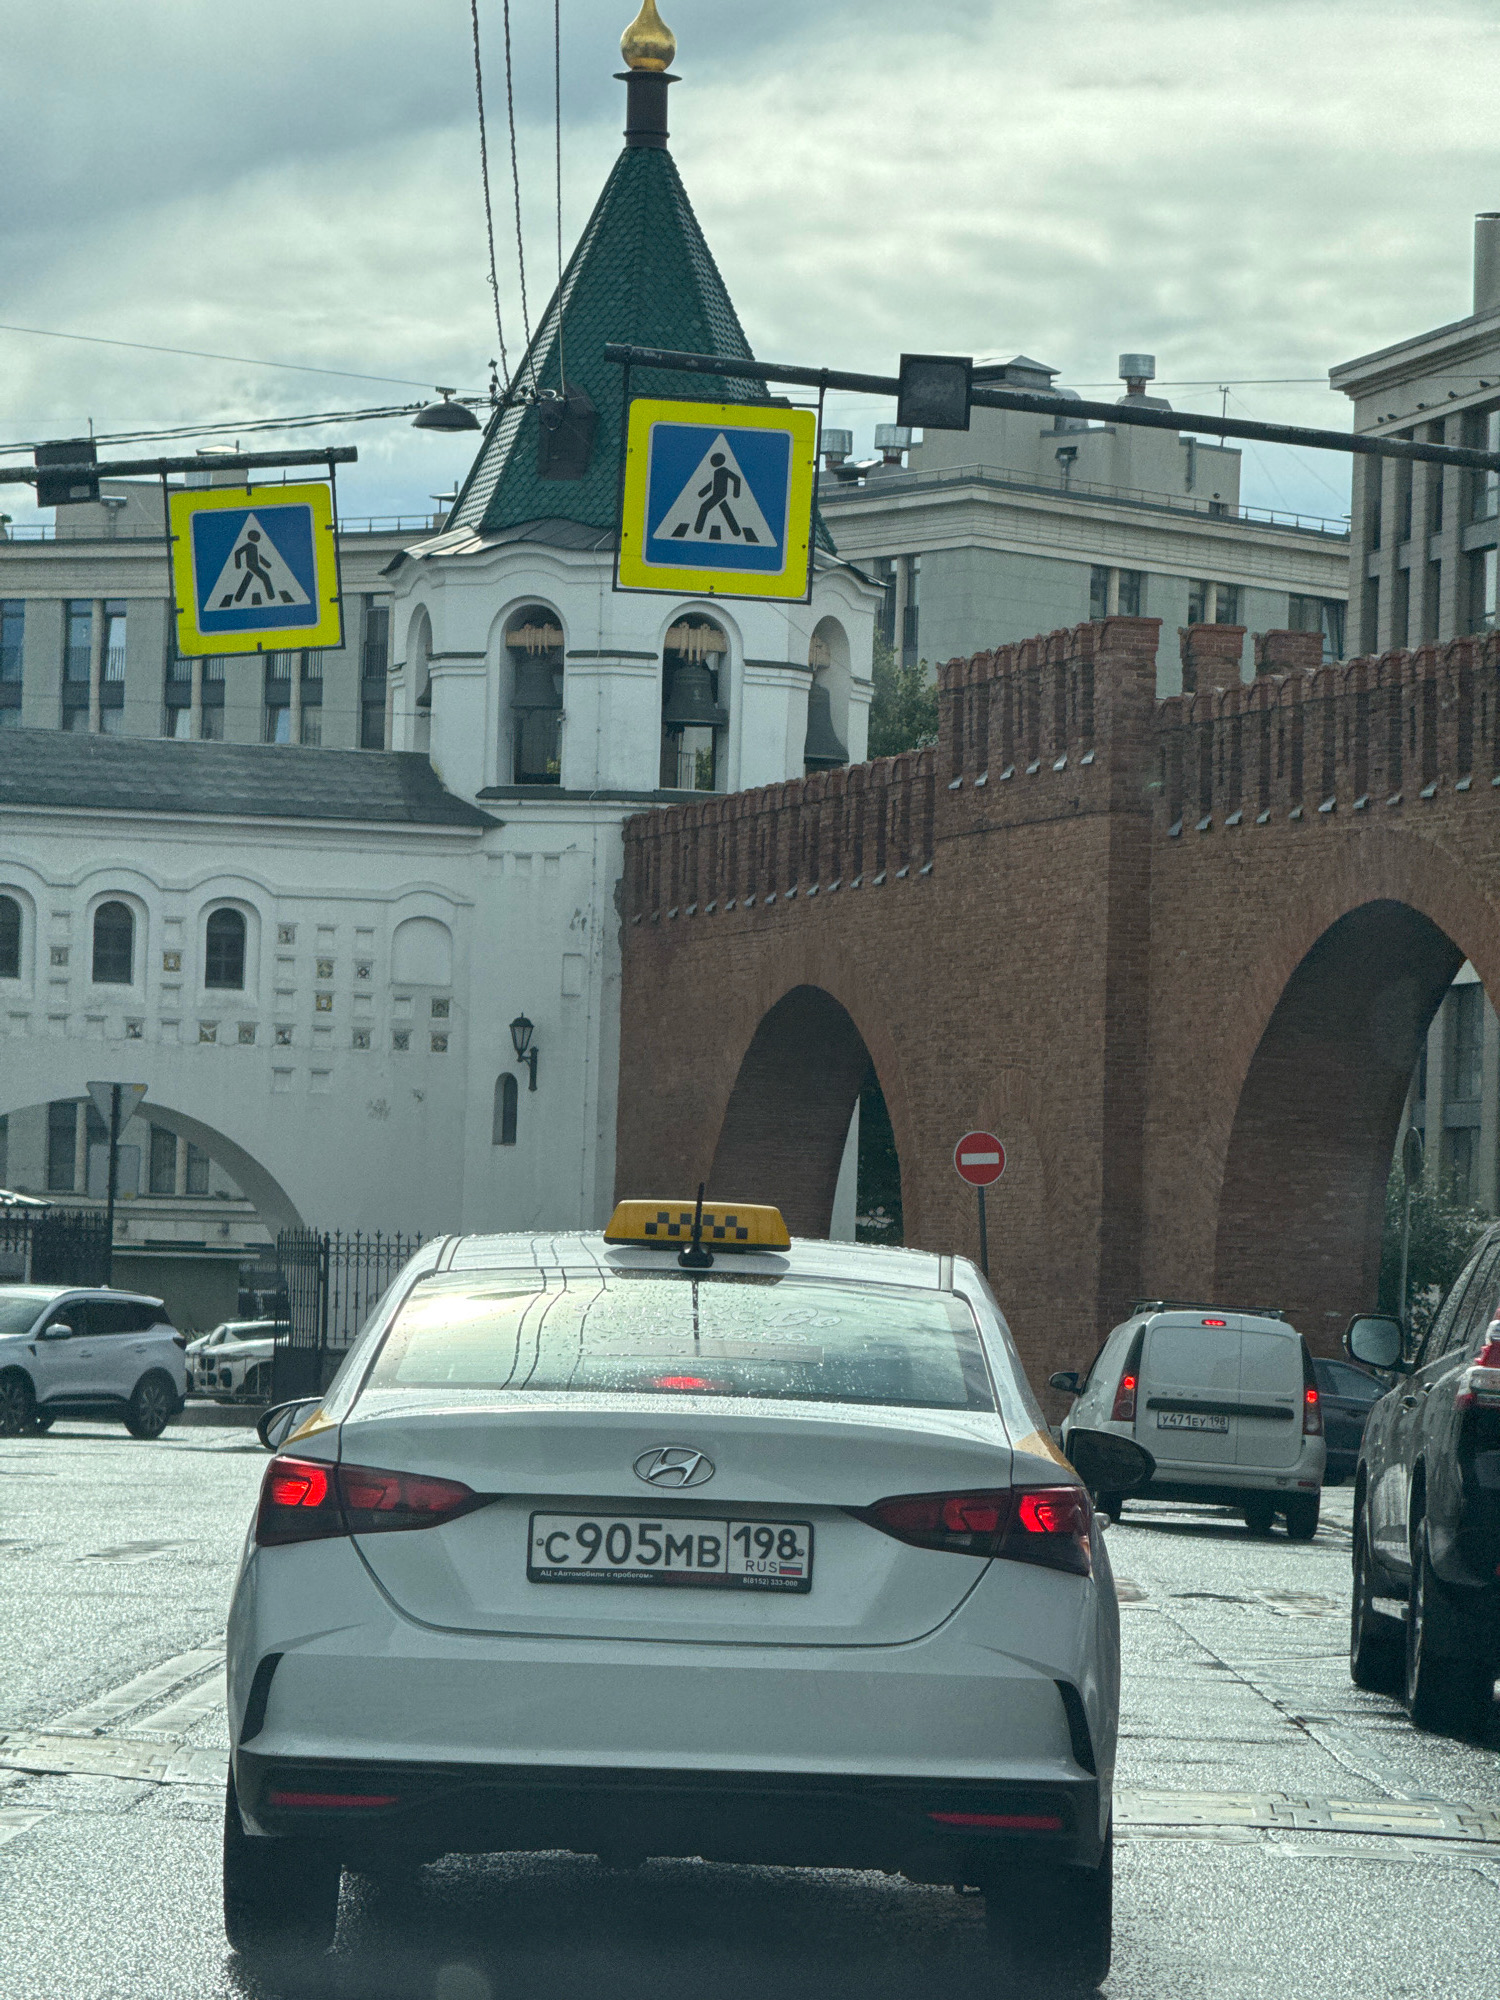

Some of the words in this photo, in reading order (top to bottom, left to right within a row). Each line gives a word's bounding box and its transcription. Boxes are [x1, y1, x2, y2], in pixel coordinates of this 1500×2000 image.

[1162, 1413, 1206, 1427] У471ЕУ
[1209, 1415, 1226, 1426] 198
[544, 1521, 721, 1568] С905МВ
[733, 1526, 798, 1561] 198
[745, 1560, 778, 1574] RUS
